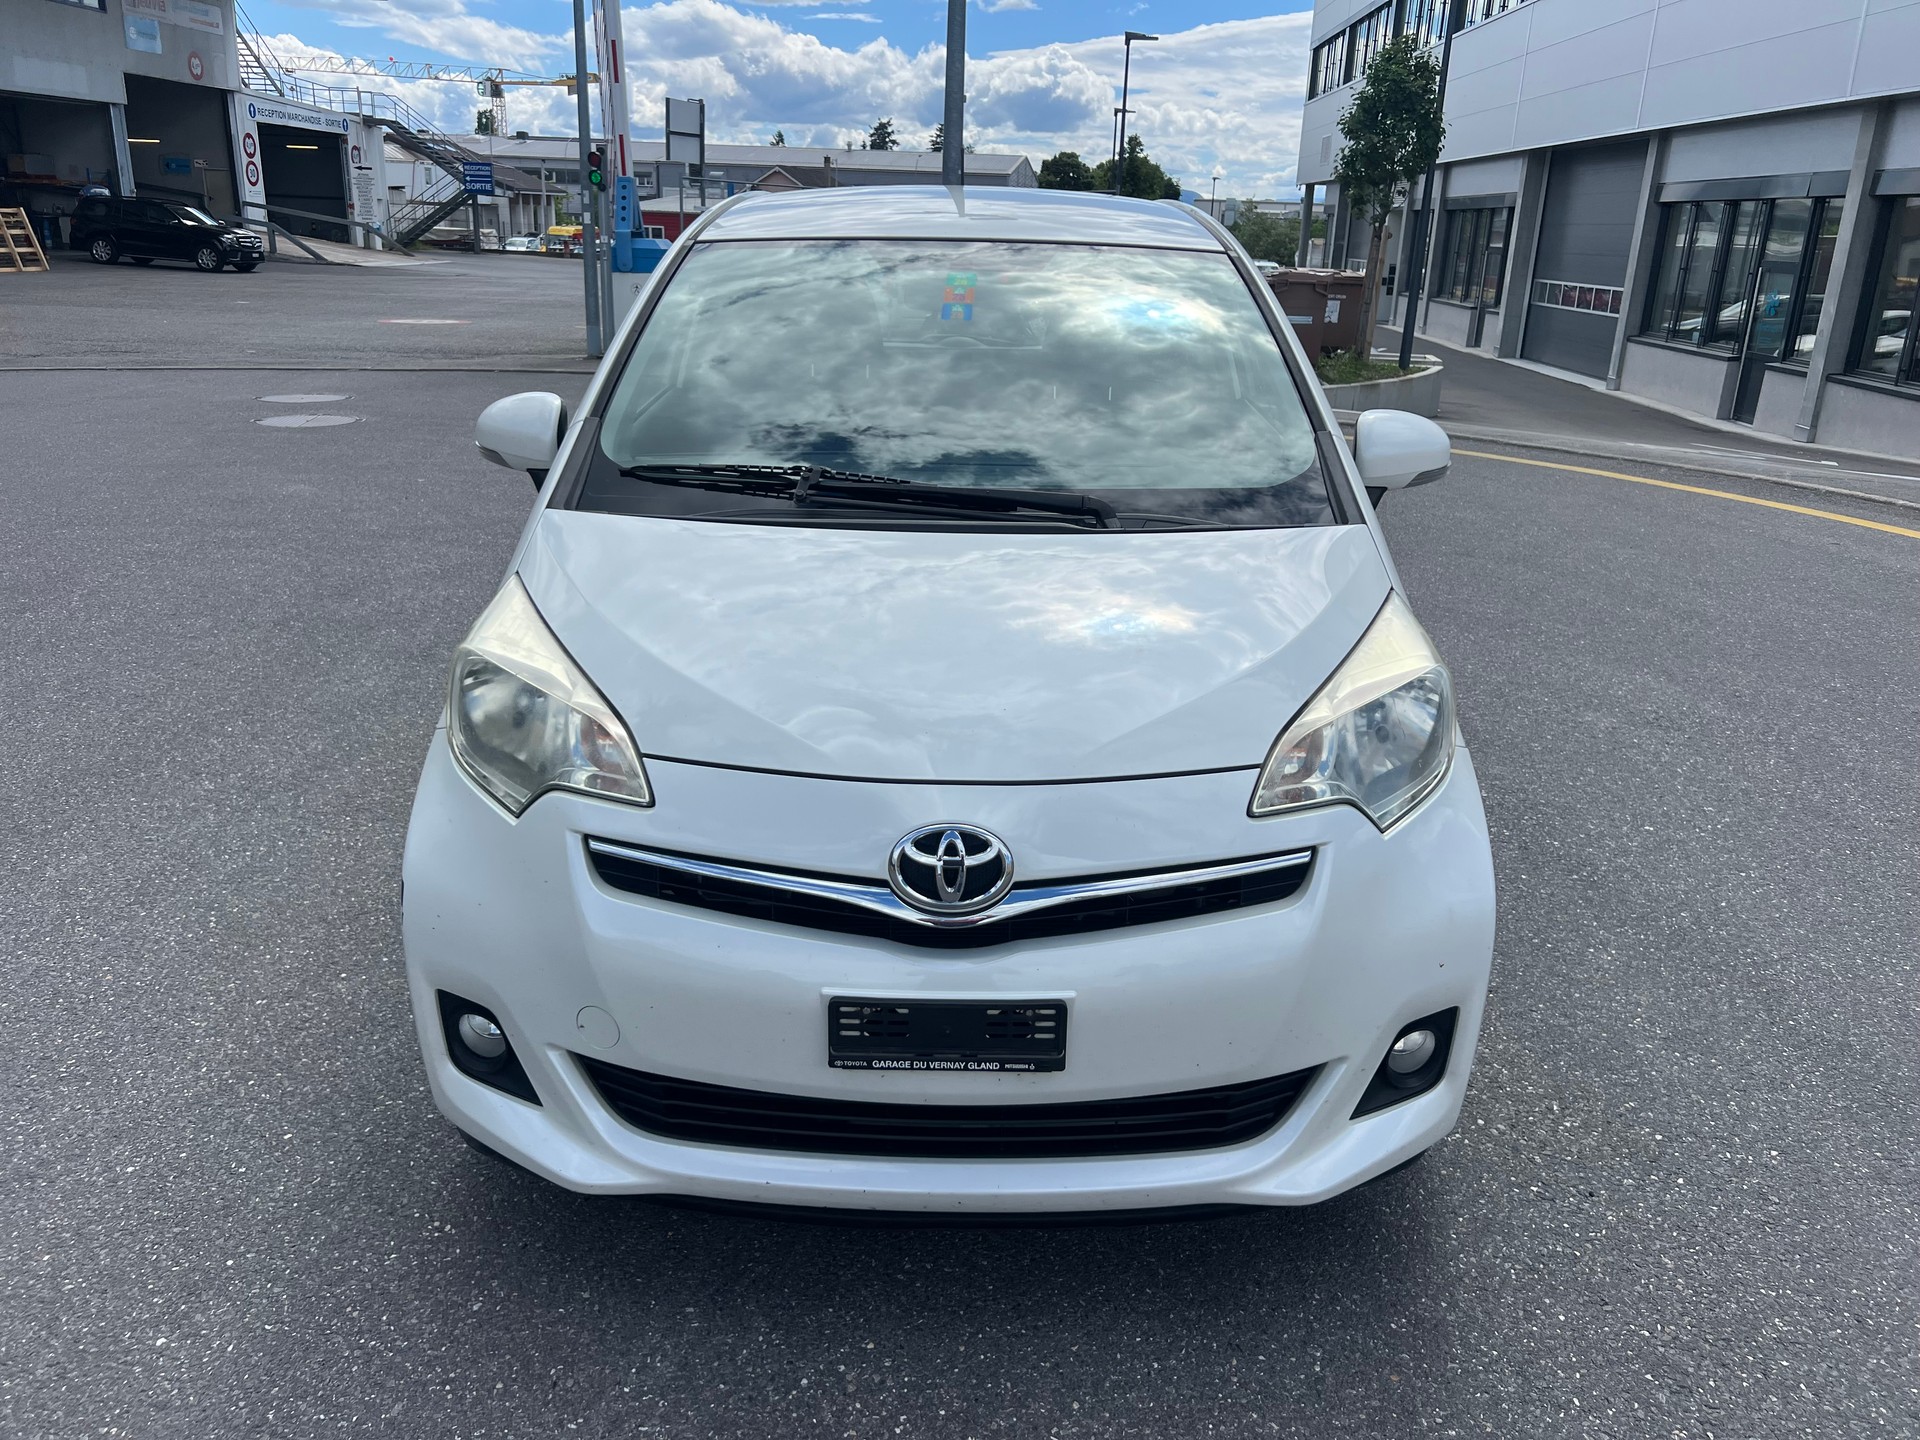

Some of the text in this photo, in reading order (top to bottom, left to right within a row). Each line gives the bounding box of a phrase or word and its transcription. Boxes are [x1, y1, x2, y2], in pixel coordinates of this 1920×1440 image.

[257, 107, 286, 120] RECEPTION
[287, 112, 322, 126] MARCHANDISE
[325, 119, 342, 128] SORTIE
[465, 182, 492, 190] SORTIE
[872, 1060, 911, 1069] GARAGE
[913, 1061, 928, 1069] DU
[929, 1061, 966, 1070] VERNAY
[967, 1061, 1000, 1070] GLAND
